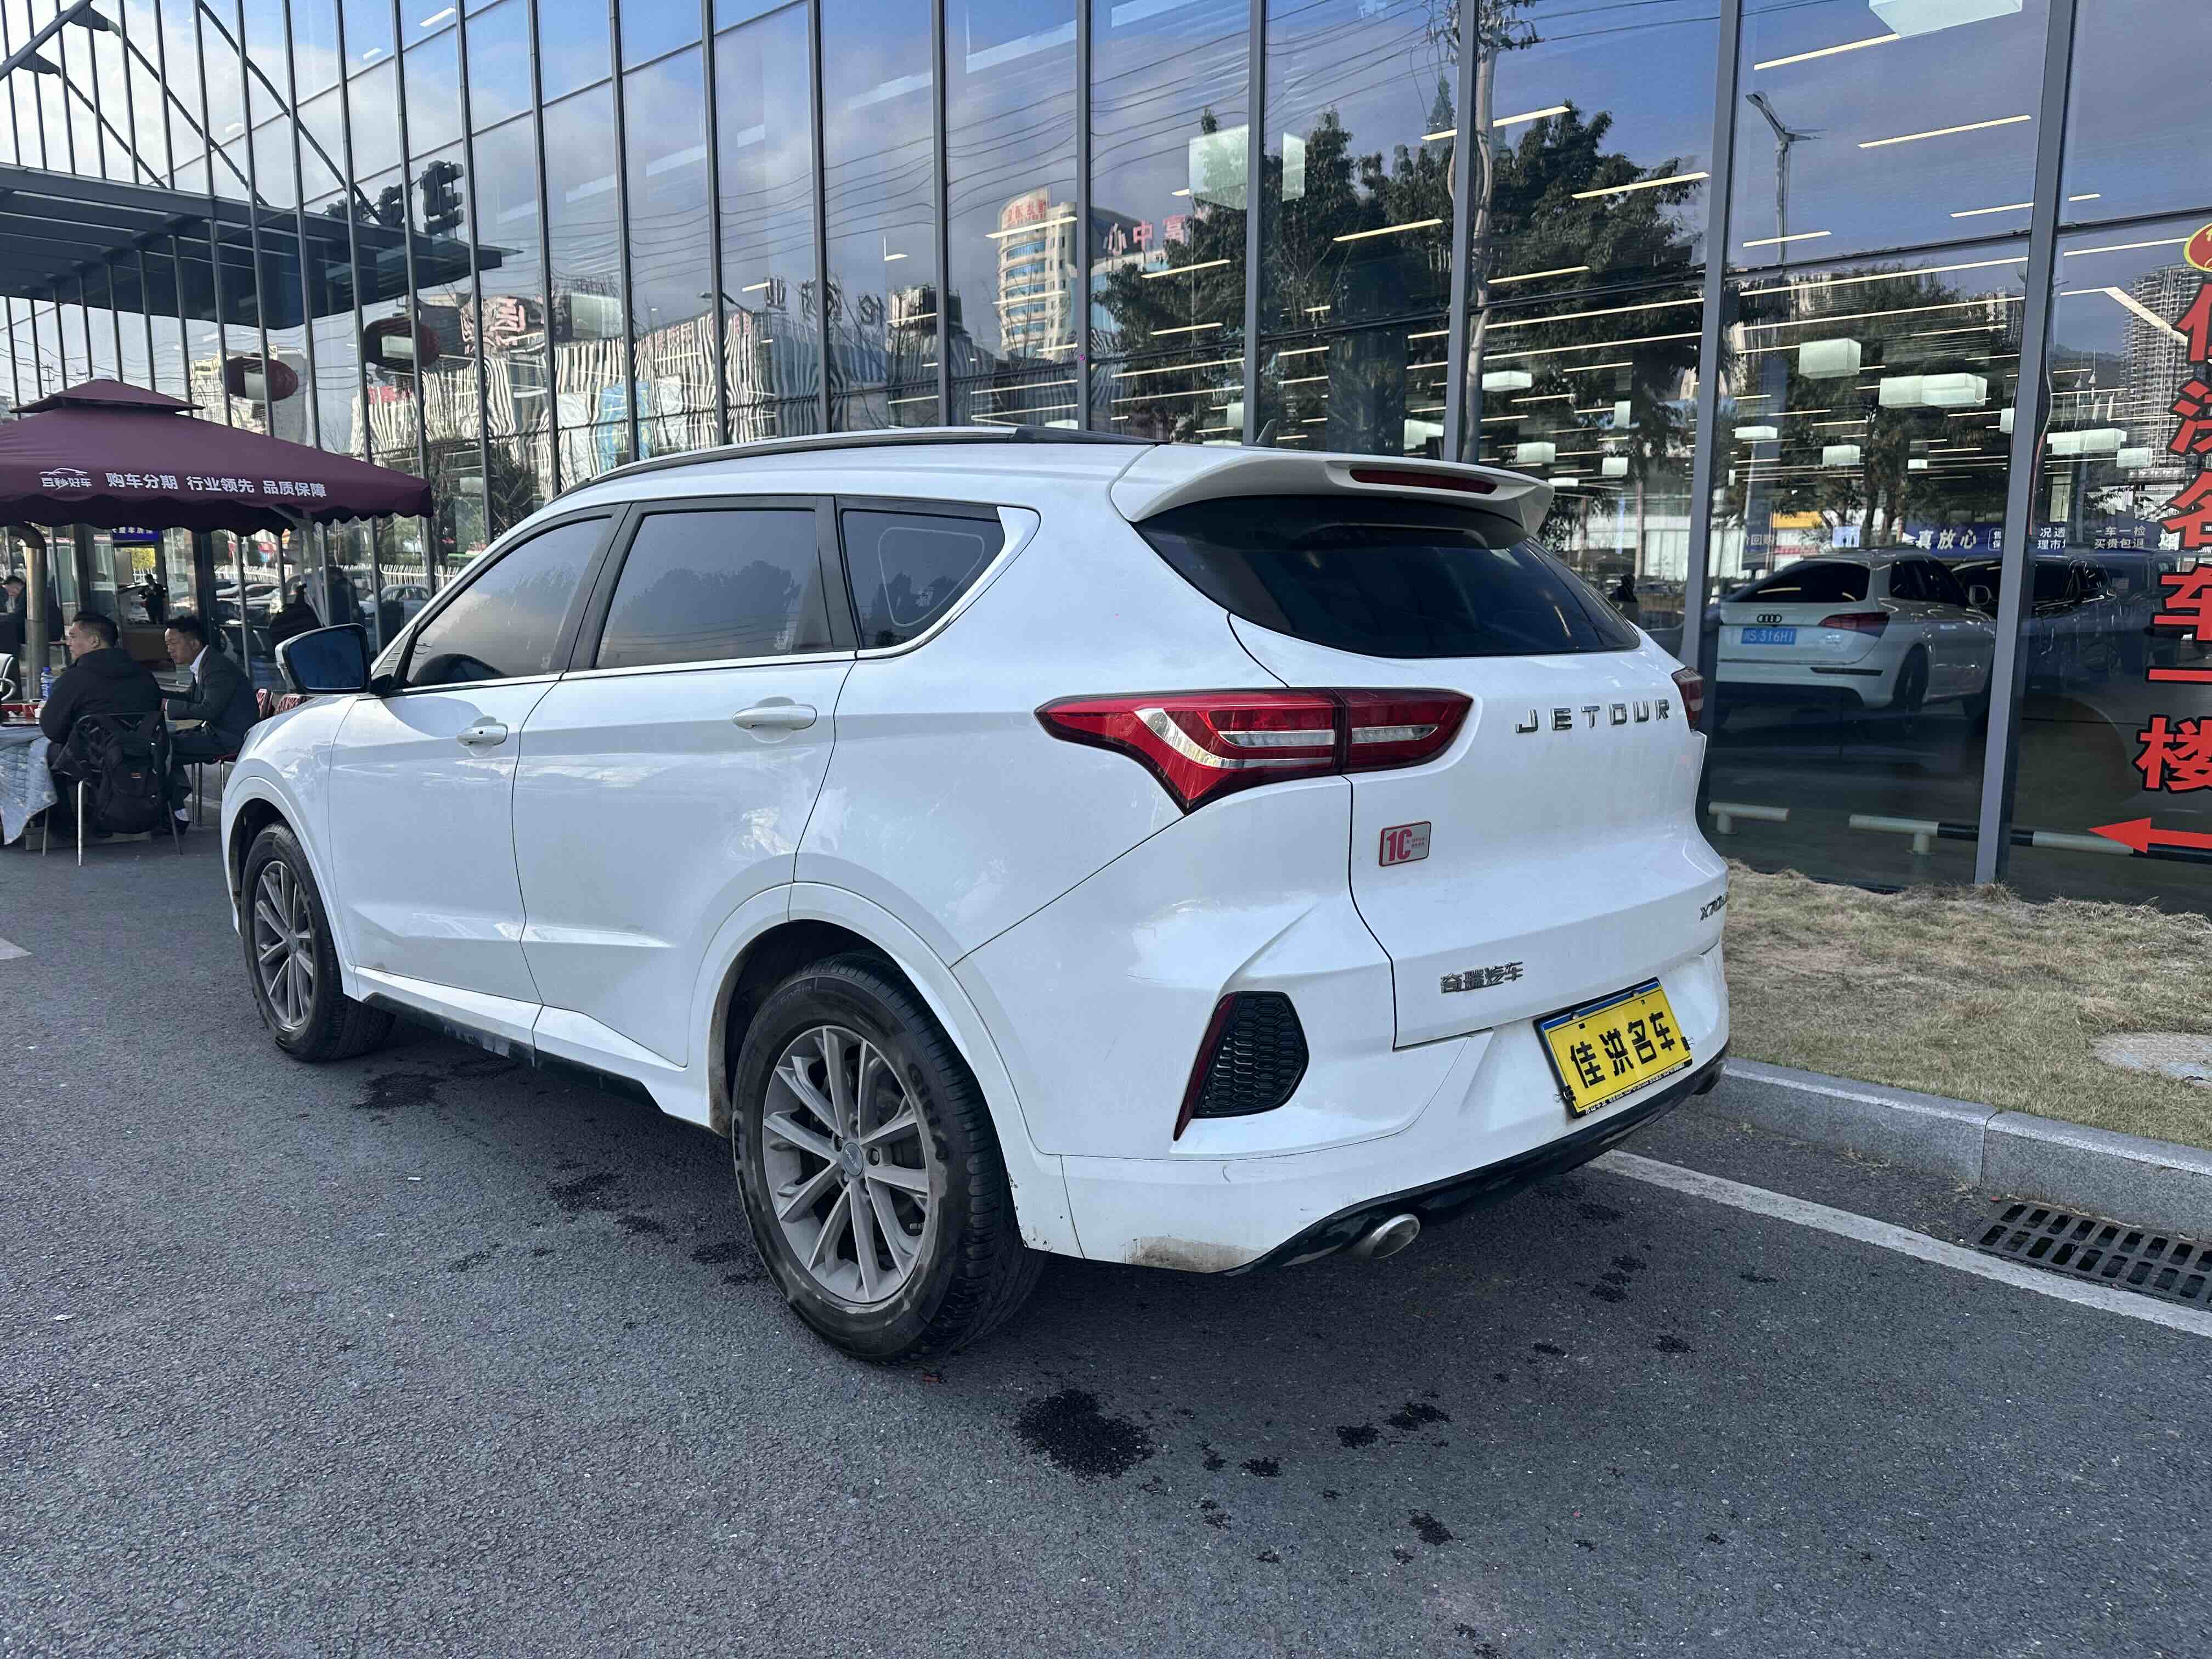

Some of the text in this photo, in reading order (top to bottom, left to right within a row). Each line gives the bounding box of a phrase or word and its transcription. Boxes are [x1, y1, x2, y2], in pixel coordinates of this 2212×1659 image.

[105, 472, 327, 498] 购车分期 行业领先 品质保障
[1916, 529, 1977, 550] 真放心
[1515, 698, 1669, 733] JETOUR
[1440, 961, 1523, 994] 奇瑞汽车
[1570, 1011, 1675, 1089] 佳洪名车
